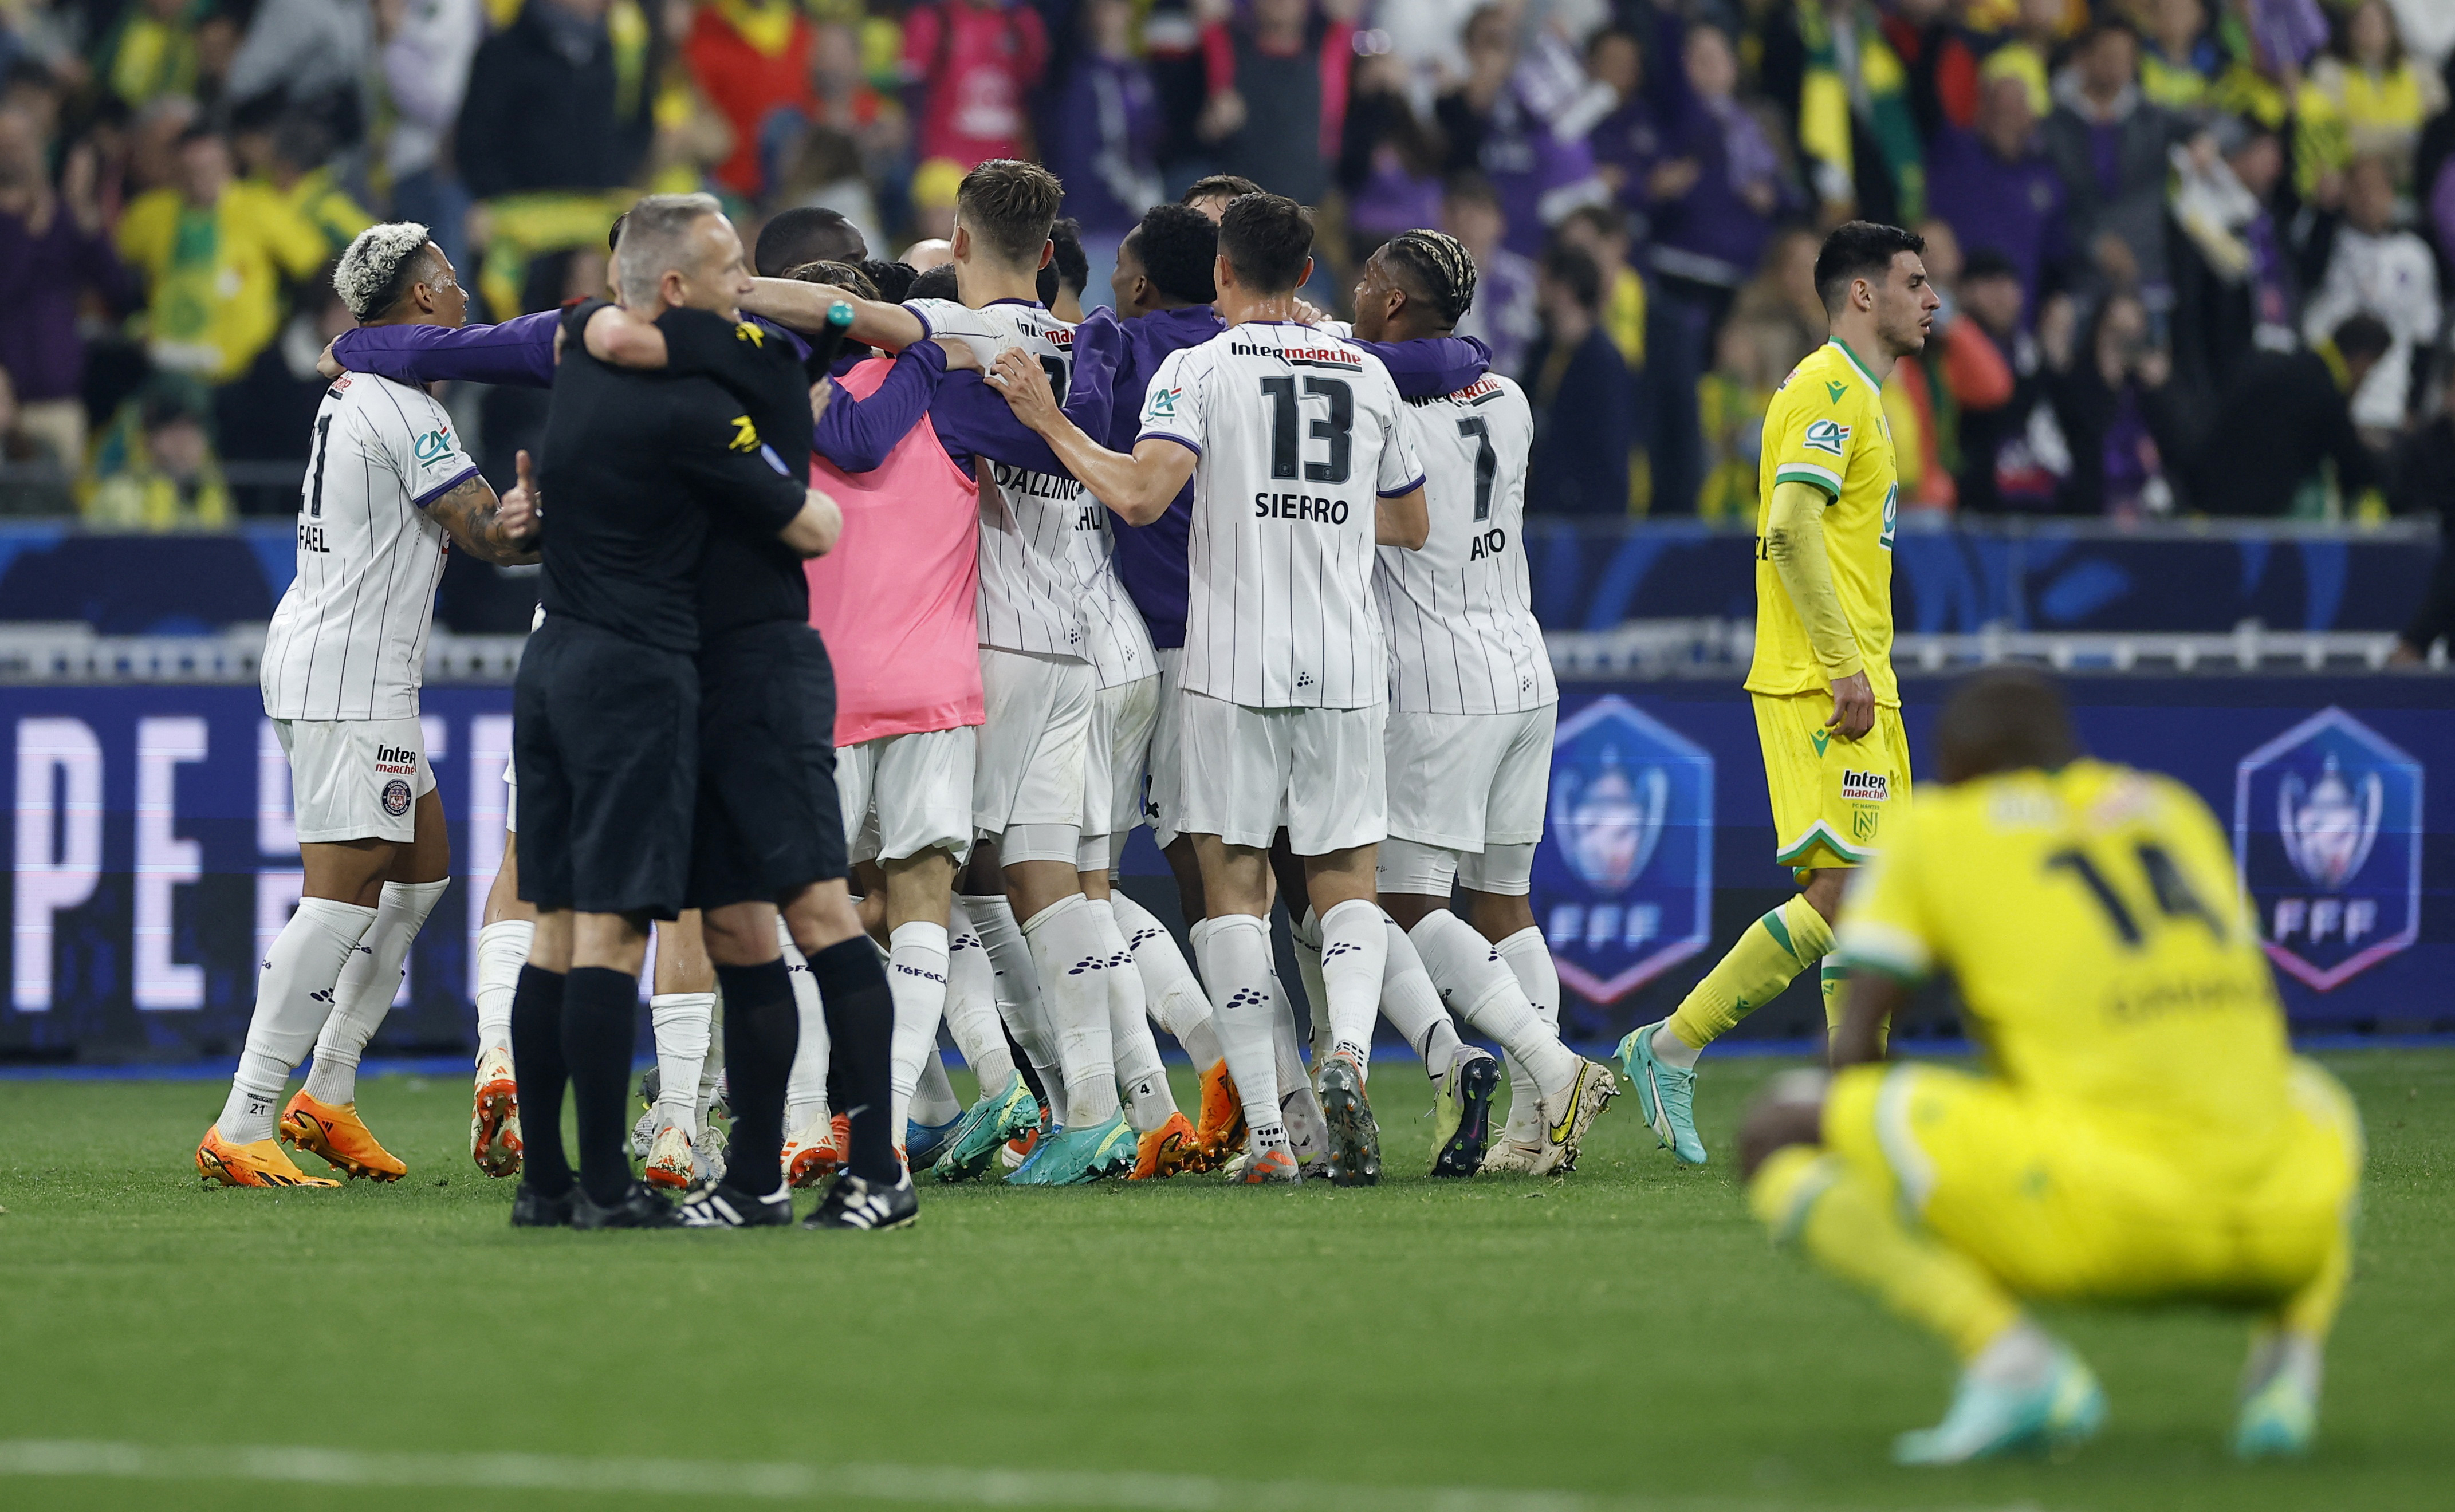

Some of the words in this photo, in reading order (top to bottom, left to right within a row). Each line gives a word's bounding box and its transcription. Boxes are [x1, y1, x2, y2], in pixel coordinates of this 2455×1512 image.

[1260, 373, 1354, 485] 13
[1455, 415, 1498, 523] 7
[1255, 492, 1349, 525] SIERRO
[377, 744, 417, 773] Inter
[1843, 770, 1888, 798] Inter
[2045, 841, 2229, 950] 14
[1140, 1083, 1150, 1094] 4
[250, 1103, 265, 1115] 21
